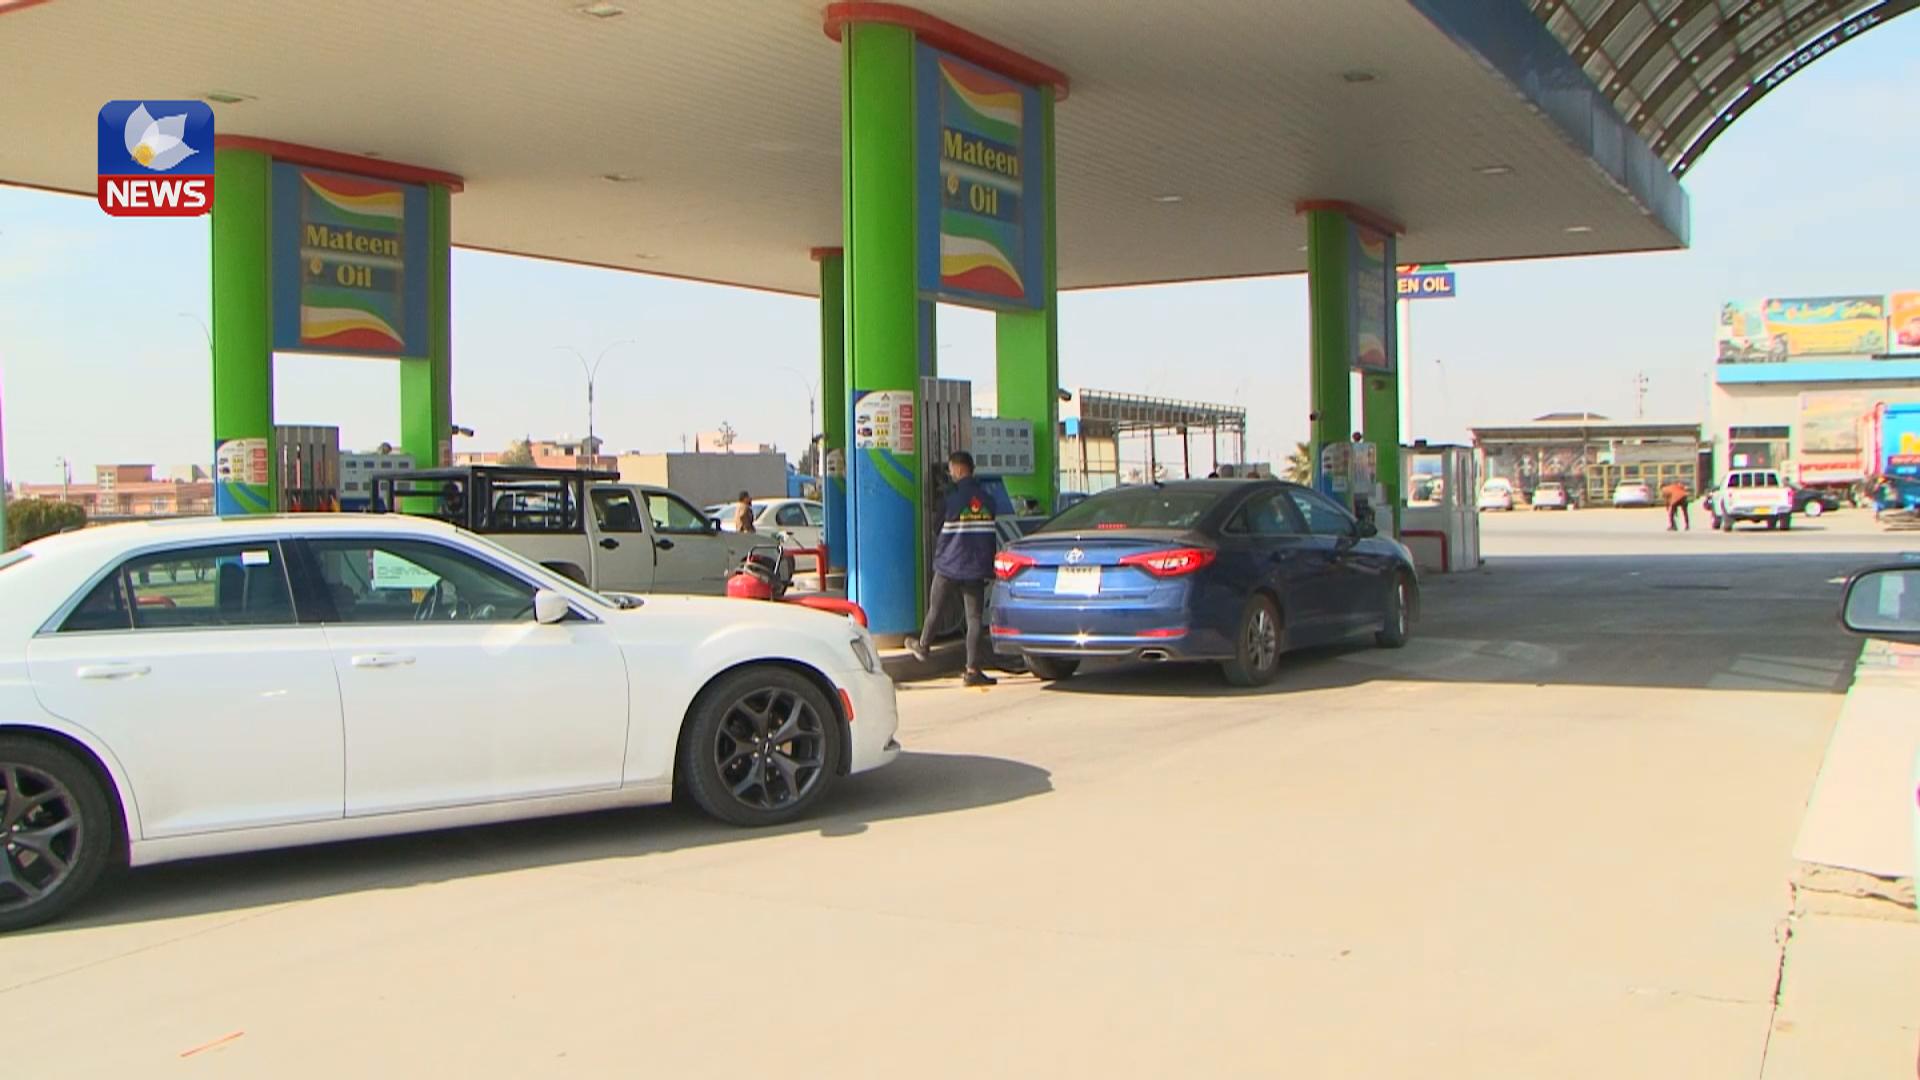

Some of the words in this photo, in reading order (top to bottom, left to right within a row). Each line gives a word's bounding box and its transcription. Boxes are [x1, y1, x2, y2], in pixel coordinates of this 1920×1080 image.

[1765, 35, 1838, 89] ARTOSH
[1843, 13, 1881, 37] OIL
[943, 129, 1019, 177] Mateen
[969, 182, 998, 216] Oil
[306, 223, 399, 256] Mateen
[336, 263, 372, 289] Oil
[1422, 276, 1451, 293] OIL
